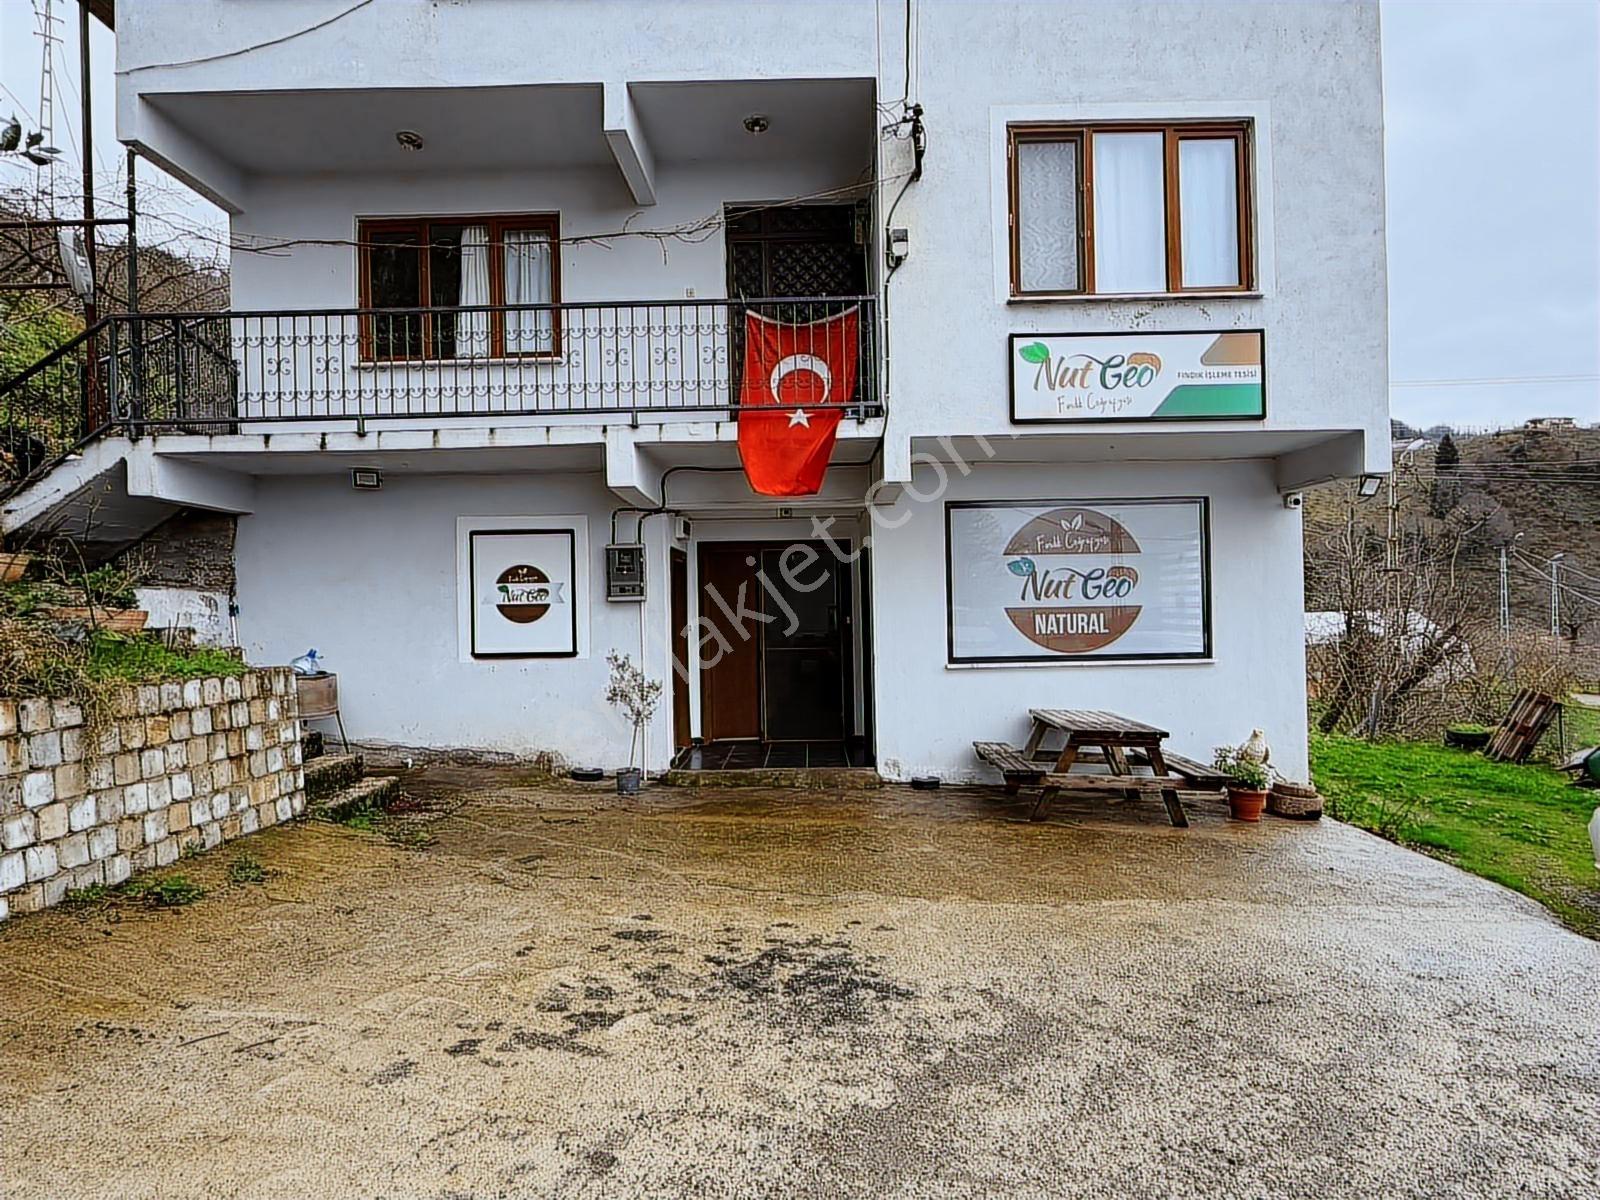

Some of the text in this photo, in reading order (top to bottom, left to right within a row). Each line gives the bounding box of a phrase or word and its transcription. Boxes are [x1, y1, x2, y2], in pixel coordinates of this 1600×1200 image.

[1034, 353, 1155, 391] Nut Geo
[1020, 567, 1133, 601] Nut Geo
[1034, 613, 1110, 635] NATURAL
